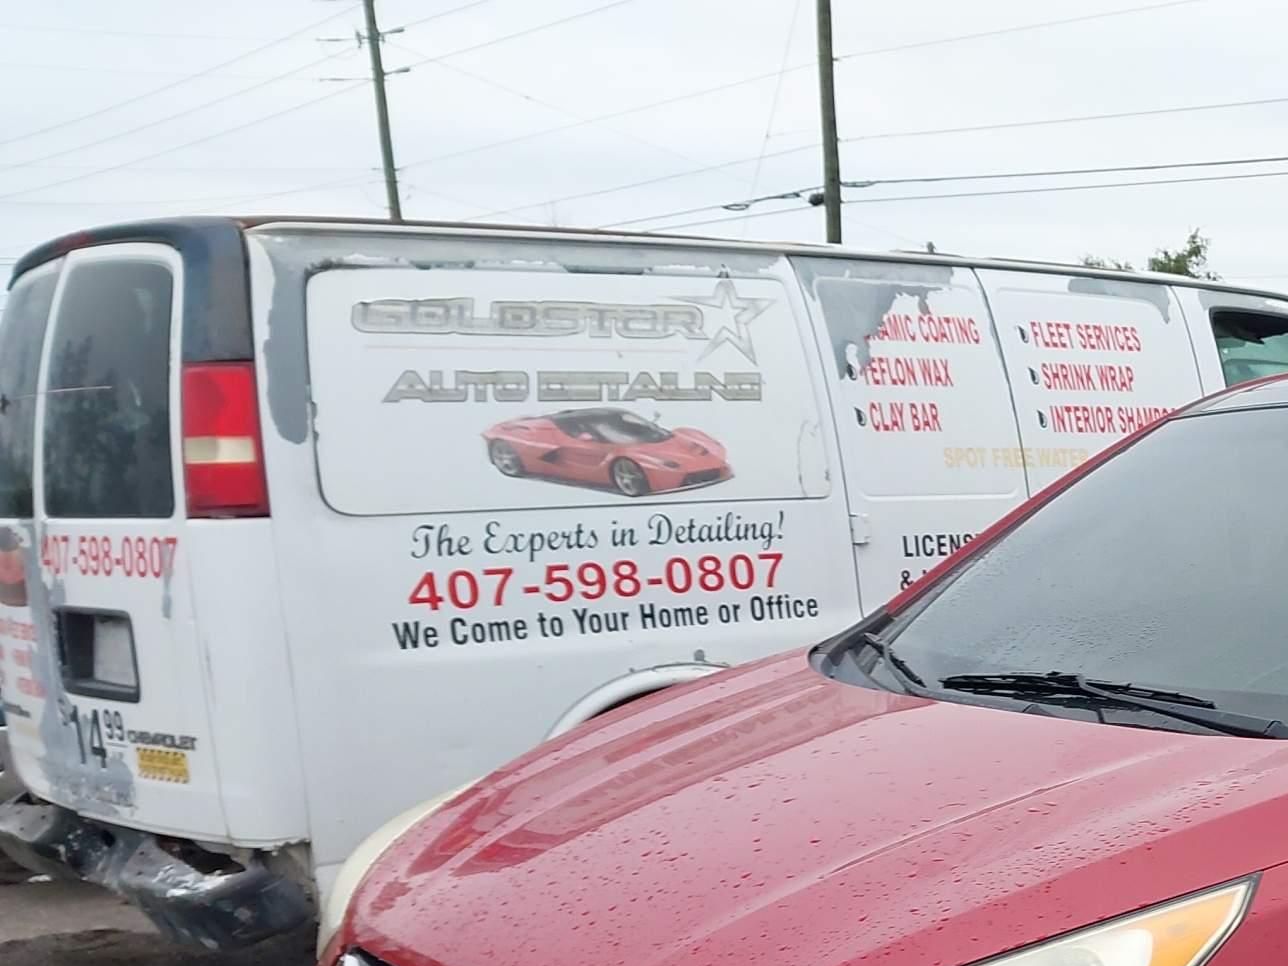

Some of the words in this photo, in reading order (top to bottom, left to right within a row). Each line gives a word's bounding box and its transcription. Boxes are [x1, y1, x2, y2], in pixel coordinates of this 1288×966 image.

[917, 315, 980, 344] COATING
[1030, 321, 1074, 348] FLEET
[1076, 324, 1142, 351] SERVICES
[381, 369, 530, 402] AUTO
[917, 358, 954, 387] WAX
[1041, 363, 1096, 391] SHRINK
[1095, 365, 1134, 391] WRAP
[869, 401, 905, 432] CLAY
[909, 402, 943, 432] BAR
[1050, 405, 1116, 433] INTERIOR
[944, 447, 986, 467] SPOT
[991, 448, 1033, 467] FREE
[1038, 448, 1089, 467] WATER
[411, 523, 473, 559] The
[483, 520, 600, 562] Experts
[611, 520, 638, 547] in
[648, 510, 785, 550] Detailing!
[902, 533, 981, 557] LICEN
[41, 534, 178, 578] 407-598-0807
[408, 552, 784, 610] 407-598-0807
[391, 621, 439, 650] We
[450, 617, 528, 645] Come
[538, 611, 564, 637] to
[572, 607, 629, 635] Your
[639, 603, 709, 630] Home
[713, 604, 740, 623] or
[750, 593, 819, 621] Office
